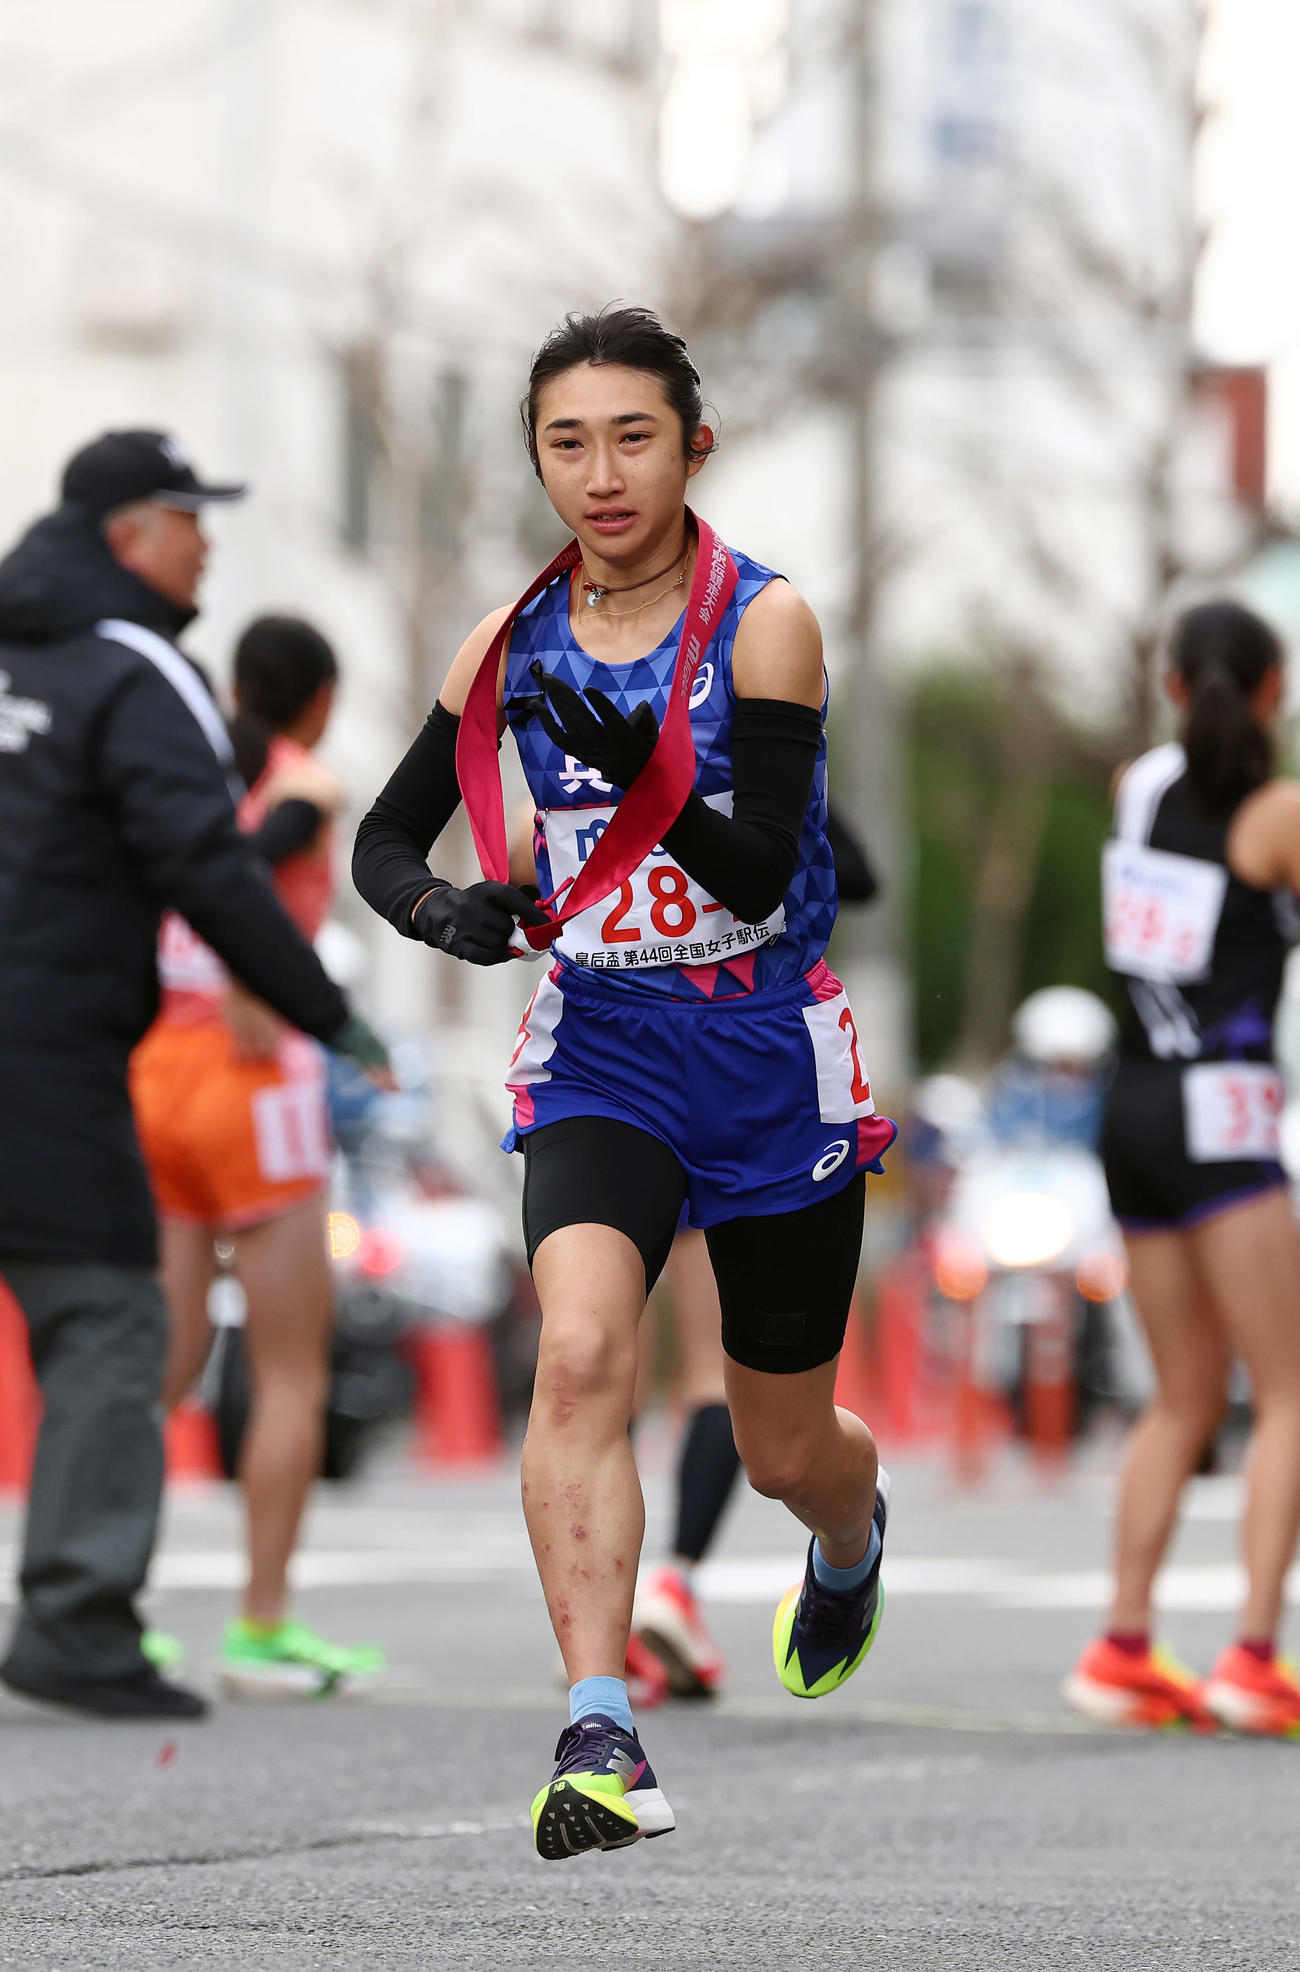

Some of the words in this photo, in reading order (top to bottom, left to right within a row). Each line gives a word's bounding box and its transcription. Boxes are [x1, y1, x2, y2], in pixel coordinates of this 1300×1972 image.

[601, 865, 739, 944] 28-
[575, 952, 621, 968] 皇后盃
[623, 922, 770, 967] 第44回全国女子駅伝
